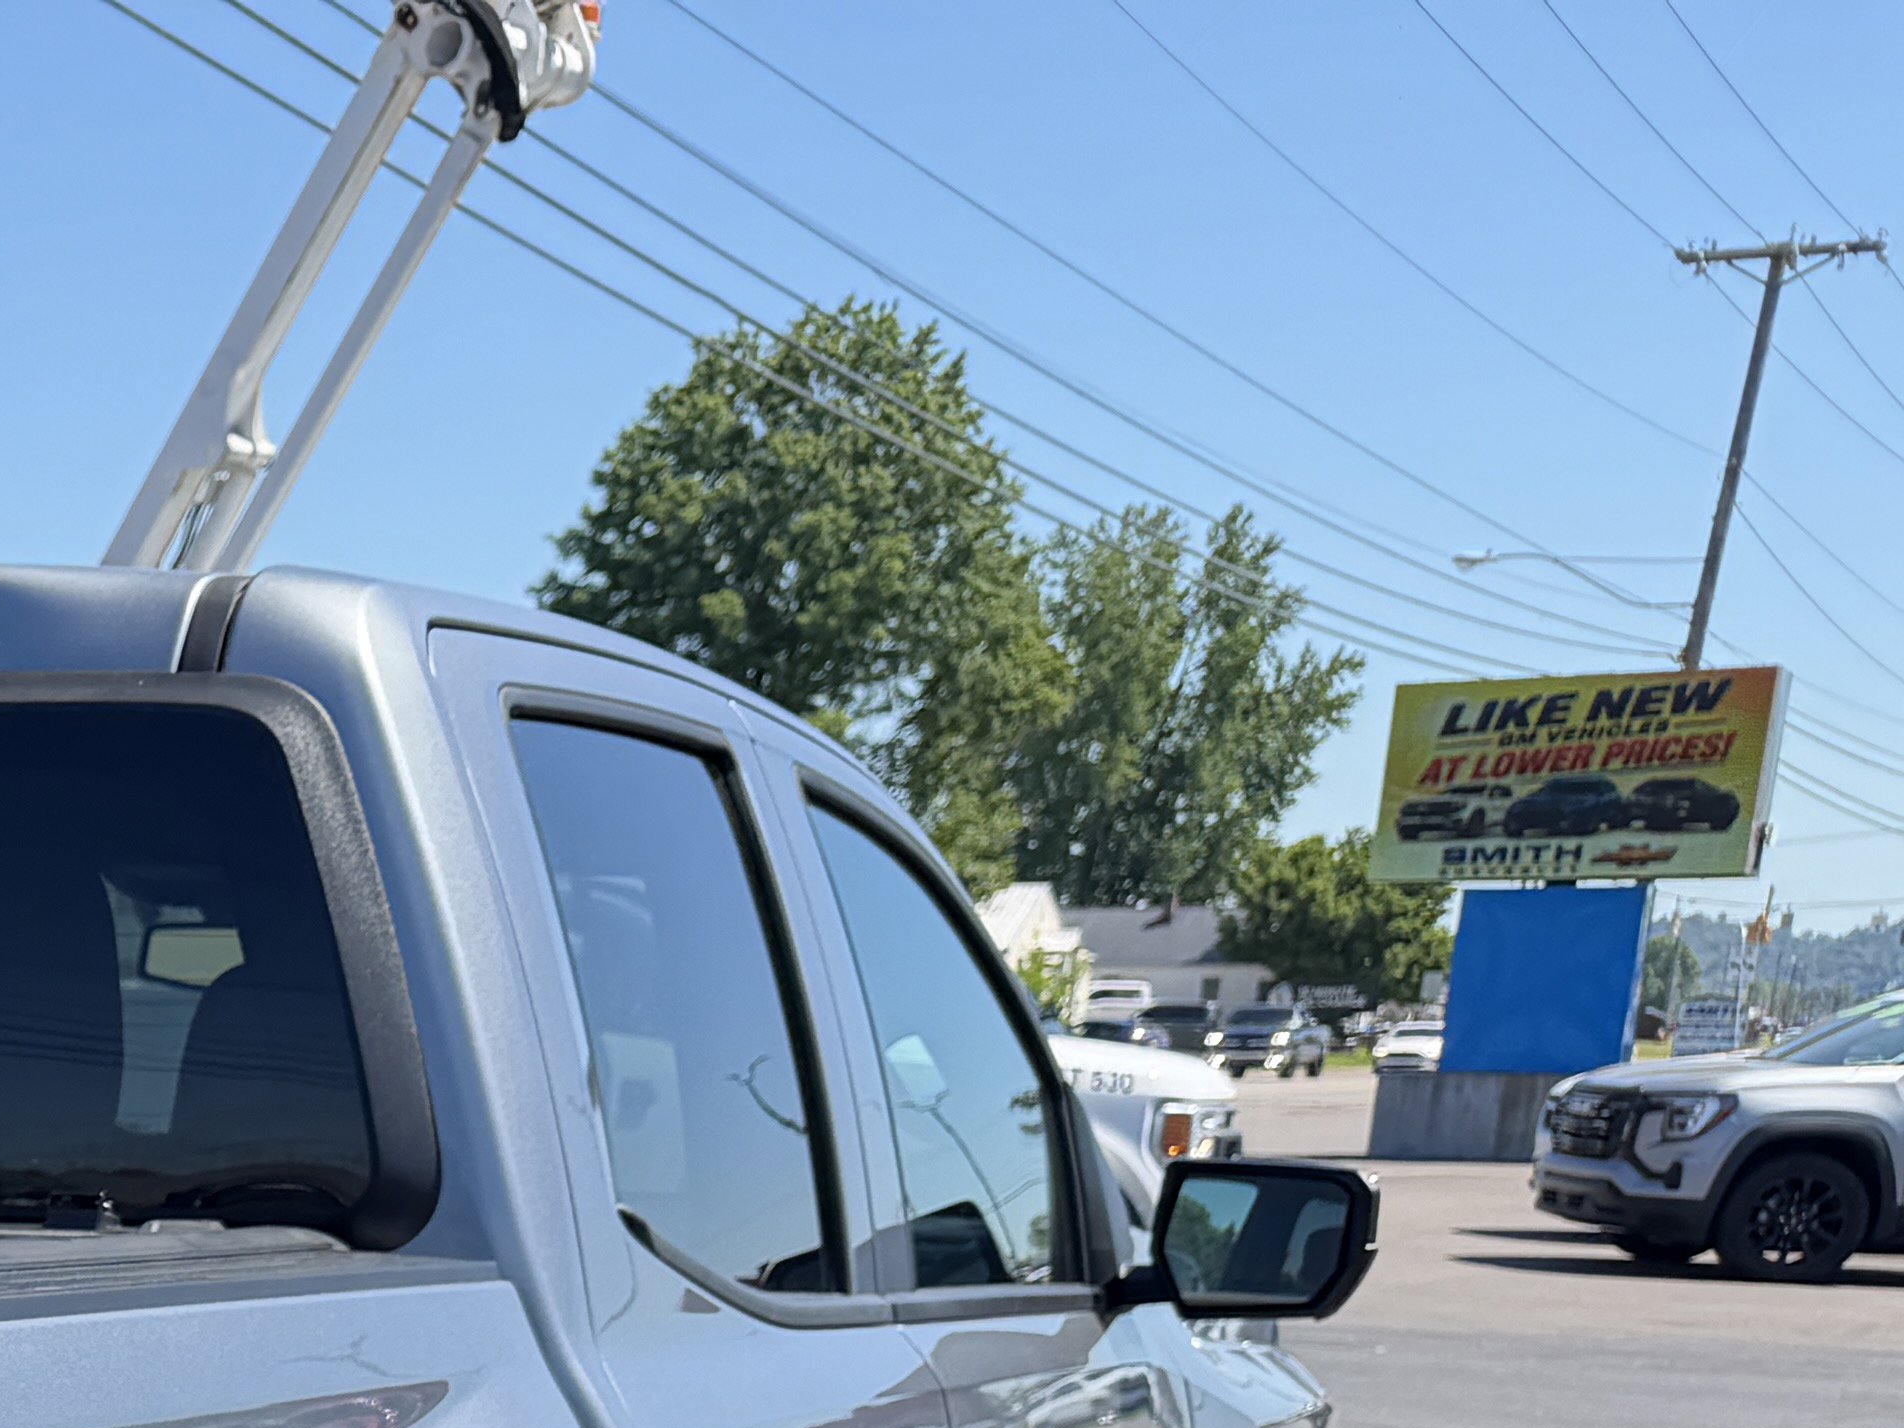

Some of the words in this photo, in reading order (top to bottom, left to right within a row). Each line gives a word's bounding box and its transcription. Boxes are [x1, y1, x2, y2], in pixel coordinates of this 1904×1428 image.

[1438, 691, 1580, 738] LIKE
[1586, 677, 1733, 722] NEW
[1547, 717, 1670, 743] VEHICLES
[1415, 753, 1468, 786] AT
[1470, 741, 1596, 780] LOWER
[1599, 730, 1739, 769] PRICES!
[1442, 843, 1584, 866] SMITH
